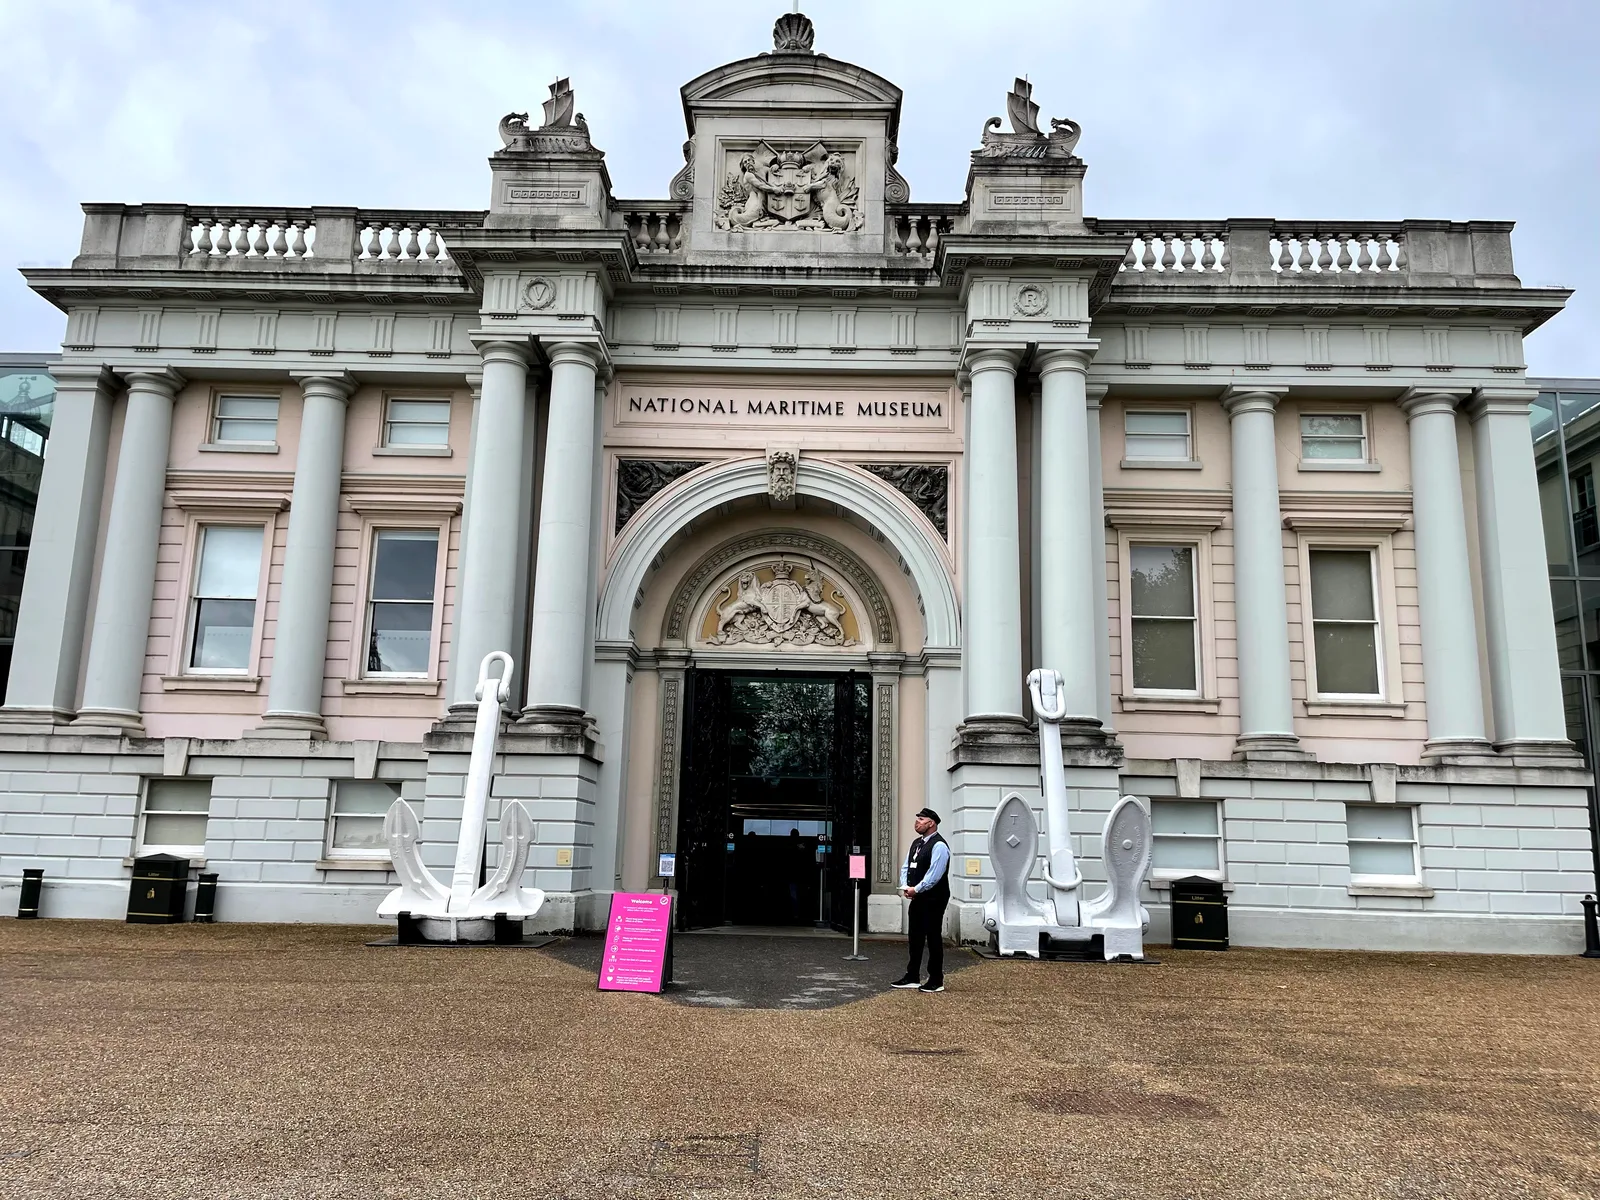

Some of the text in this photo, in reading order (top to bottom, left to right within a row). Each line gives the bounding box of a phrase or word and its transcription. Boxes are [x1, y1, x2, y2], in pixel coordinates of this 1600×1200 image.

[532, 286, 547, 301] V
[1024, 292, 1037, 307] R
[629, 397, 942, 418] NATIONAL MARITIME MUSEUM
[1010, 814, 1019, 825] T
